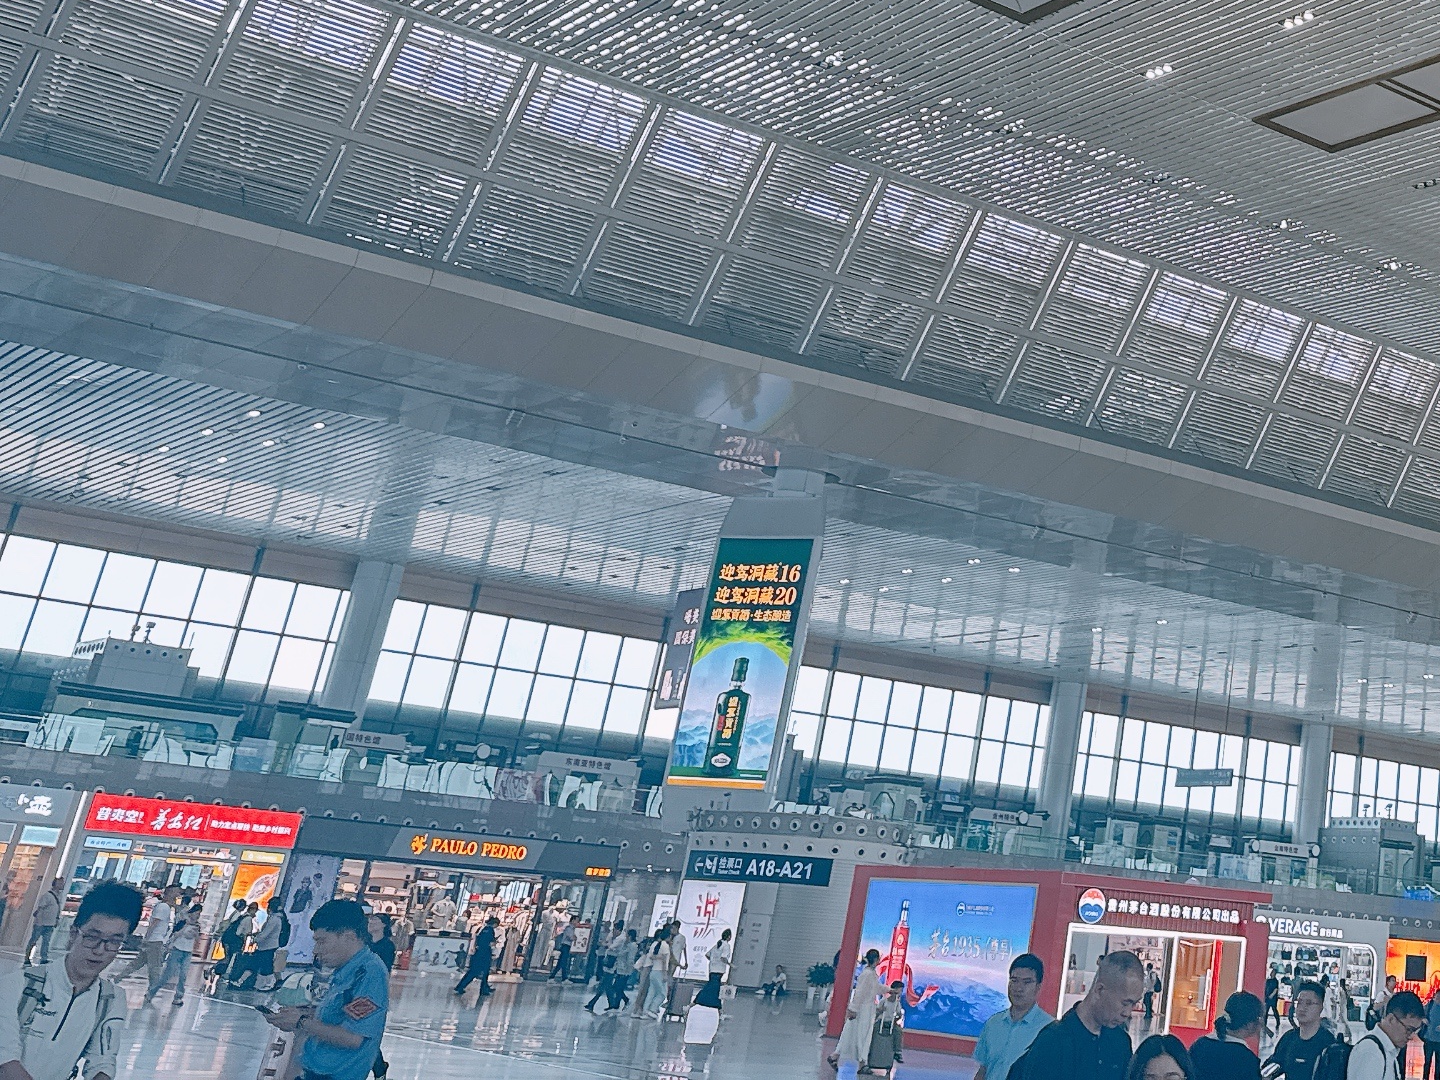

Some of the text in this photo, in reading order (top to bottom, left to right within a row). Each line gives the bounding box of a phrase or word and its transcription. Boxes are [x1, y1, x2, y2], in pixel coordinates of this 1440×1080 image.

[719, 562, 801, 583] 迎驾洞藏16
[714, 586, 797, 606] 迎驾洞藏20
[430, 837, 528, 861] PAULO PEDRO
[718, 856, 813, 880] 检票口 A18-A21
[1107, 898, 1240, 925] 贵州茅台酒股份有限公司出品
